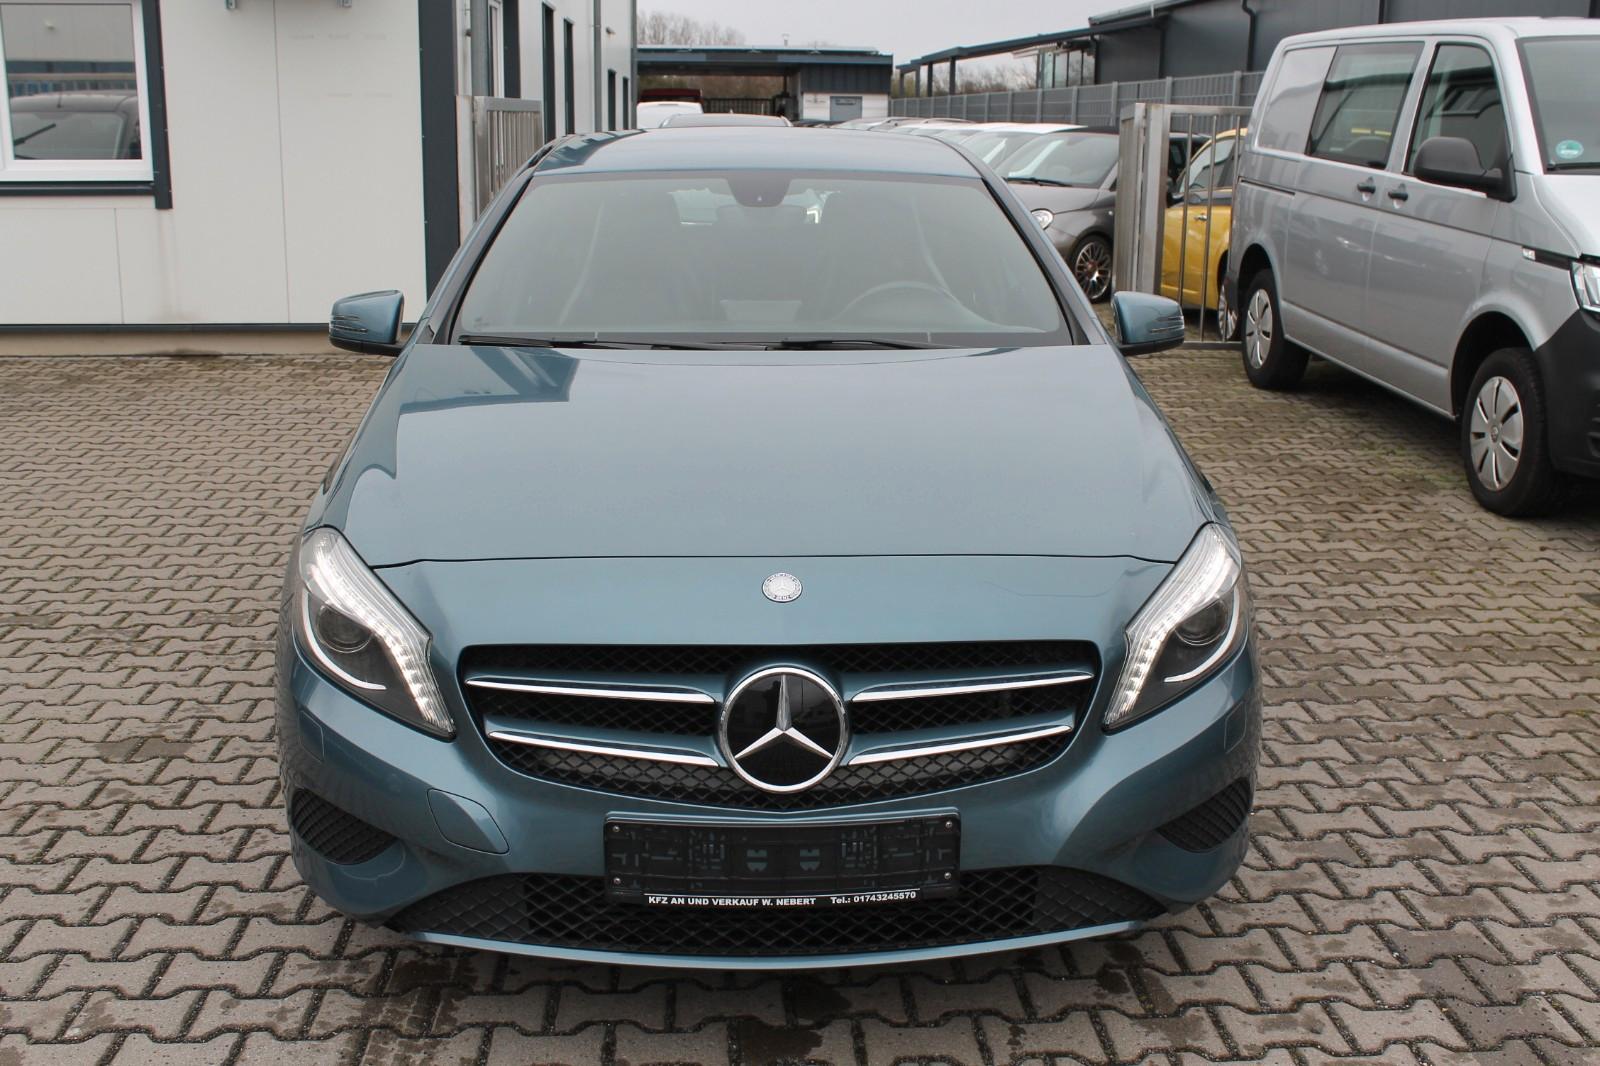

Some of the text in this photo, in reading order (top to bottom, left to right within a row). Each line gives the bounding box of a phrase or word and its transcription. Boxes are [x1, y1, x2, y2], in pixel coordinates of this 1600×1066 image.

[648, 896, 668, 904] KFZ
[670, 897, 685, 905] AN
[712, 898, 759, 906] VERKAUF
[761, 898, 773, 906] W.
[776, 897, 816, 906] NEBERT
[830, 896, 851, 904] Tel.:
[853, 891, 916, 903] 01743245570
